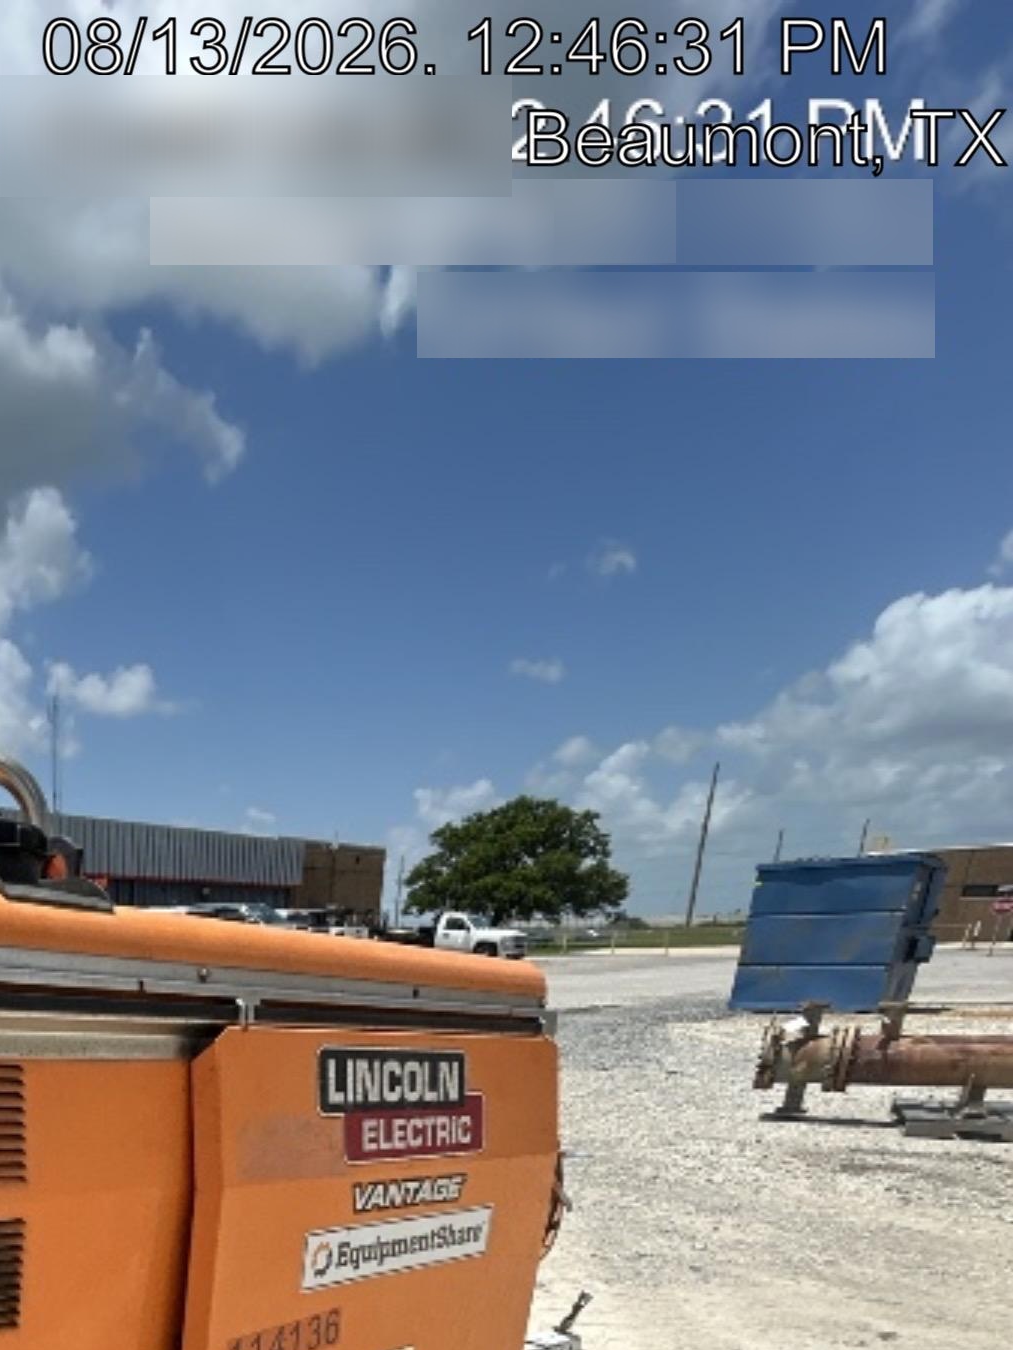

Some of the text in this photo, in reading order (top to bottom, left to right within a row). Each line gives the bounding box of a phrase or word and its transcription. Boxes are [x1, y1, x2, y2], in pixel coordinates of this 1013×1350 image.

[326, 1058, 461, 1104] LINCOLN
[361, 1115, 472, 1152] ELECTRIC
[352, 1174, 468, 1214] VANTAGE
[334, 1223, 483, 1270] EquipmentShare
